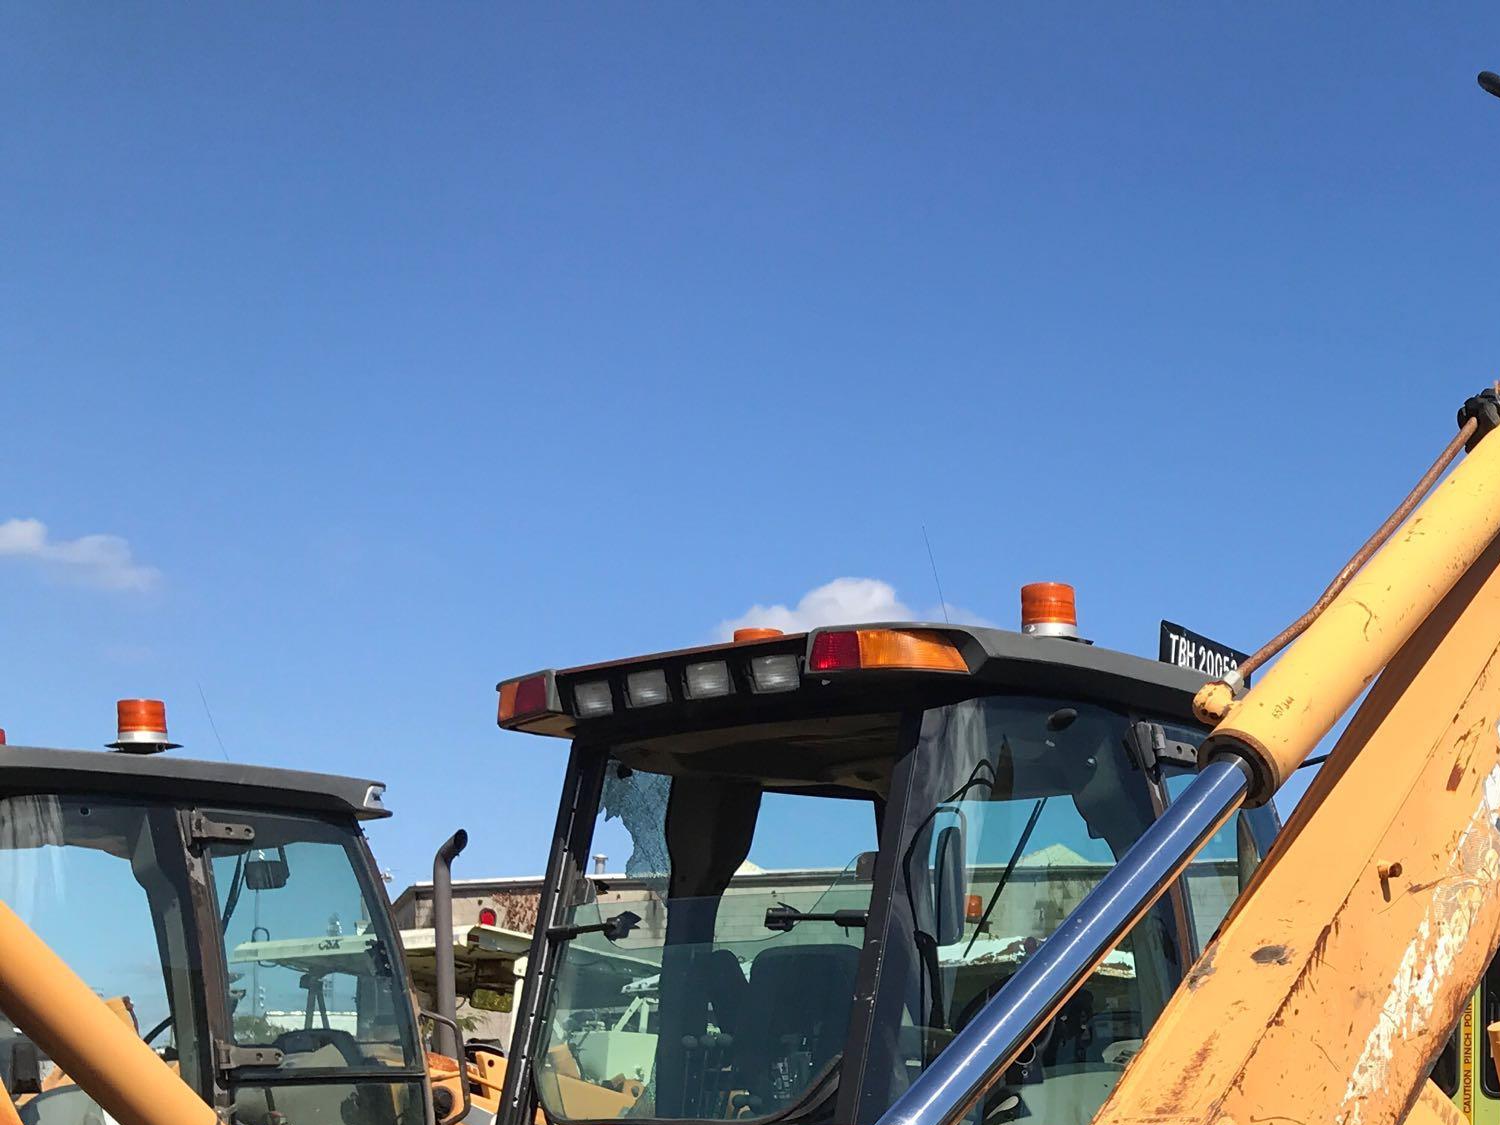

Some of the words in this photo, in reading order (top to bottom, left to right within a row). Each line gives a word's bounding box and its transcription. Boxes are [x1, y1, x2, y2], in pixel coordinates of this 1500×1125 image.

[1169, 633, 1196, 670] TBH
[1464, 1033, 1473, 1064] PINCH
[1463, 1069, 1473, 1114] CAUTION
